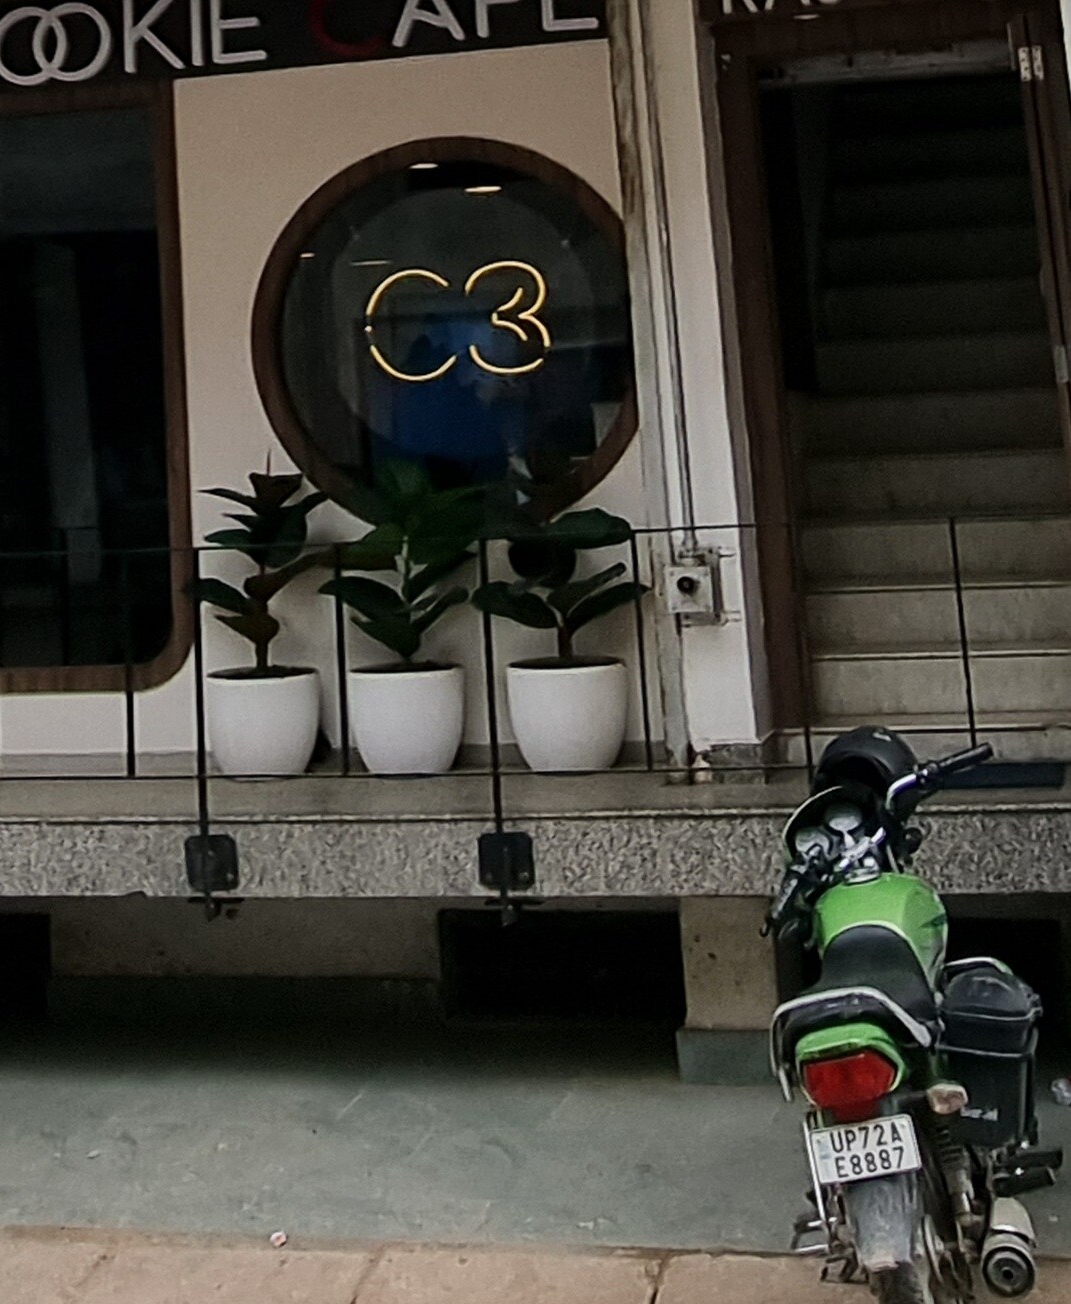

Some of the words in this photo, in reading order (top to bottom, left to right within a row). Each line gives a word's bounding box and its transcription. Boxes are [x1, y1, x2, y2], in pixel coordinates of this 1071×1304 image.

[365, 260, 551, 381] C3
[830, 1122, 903, 1153] UP72A
[835, 1147, 904, 1178] E8887
